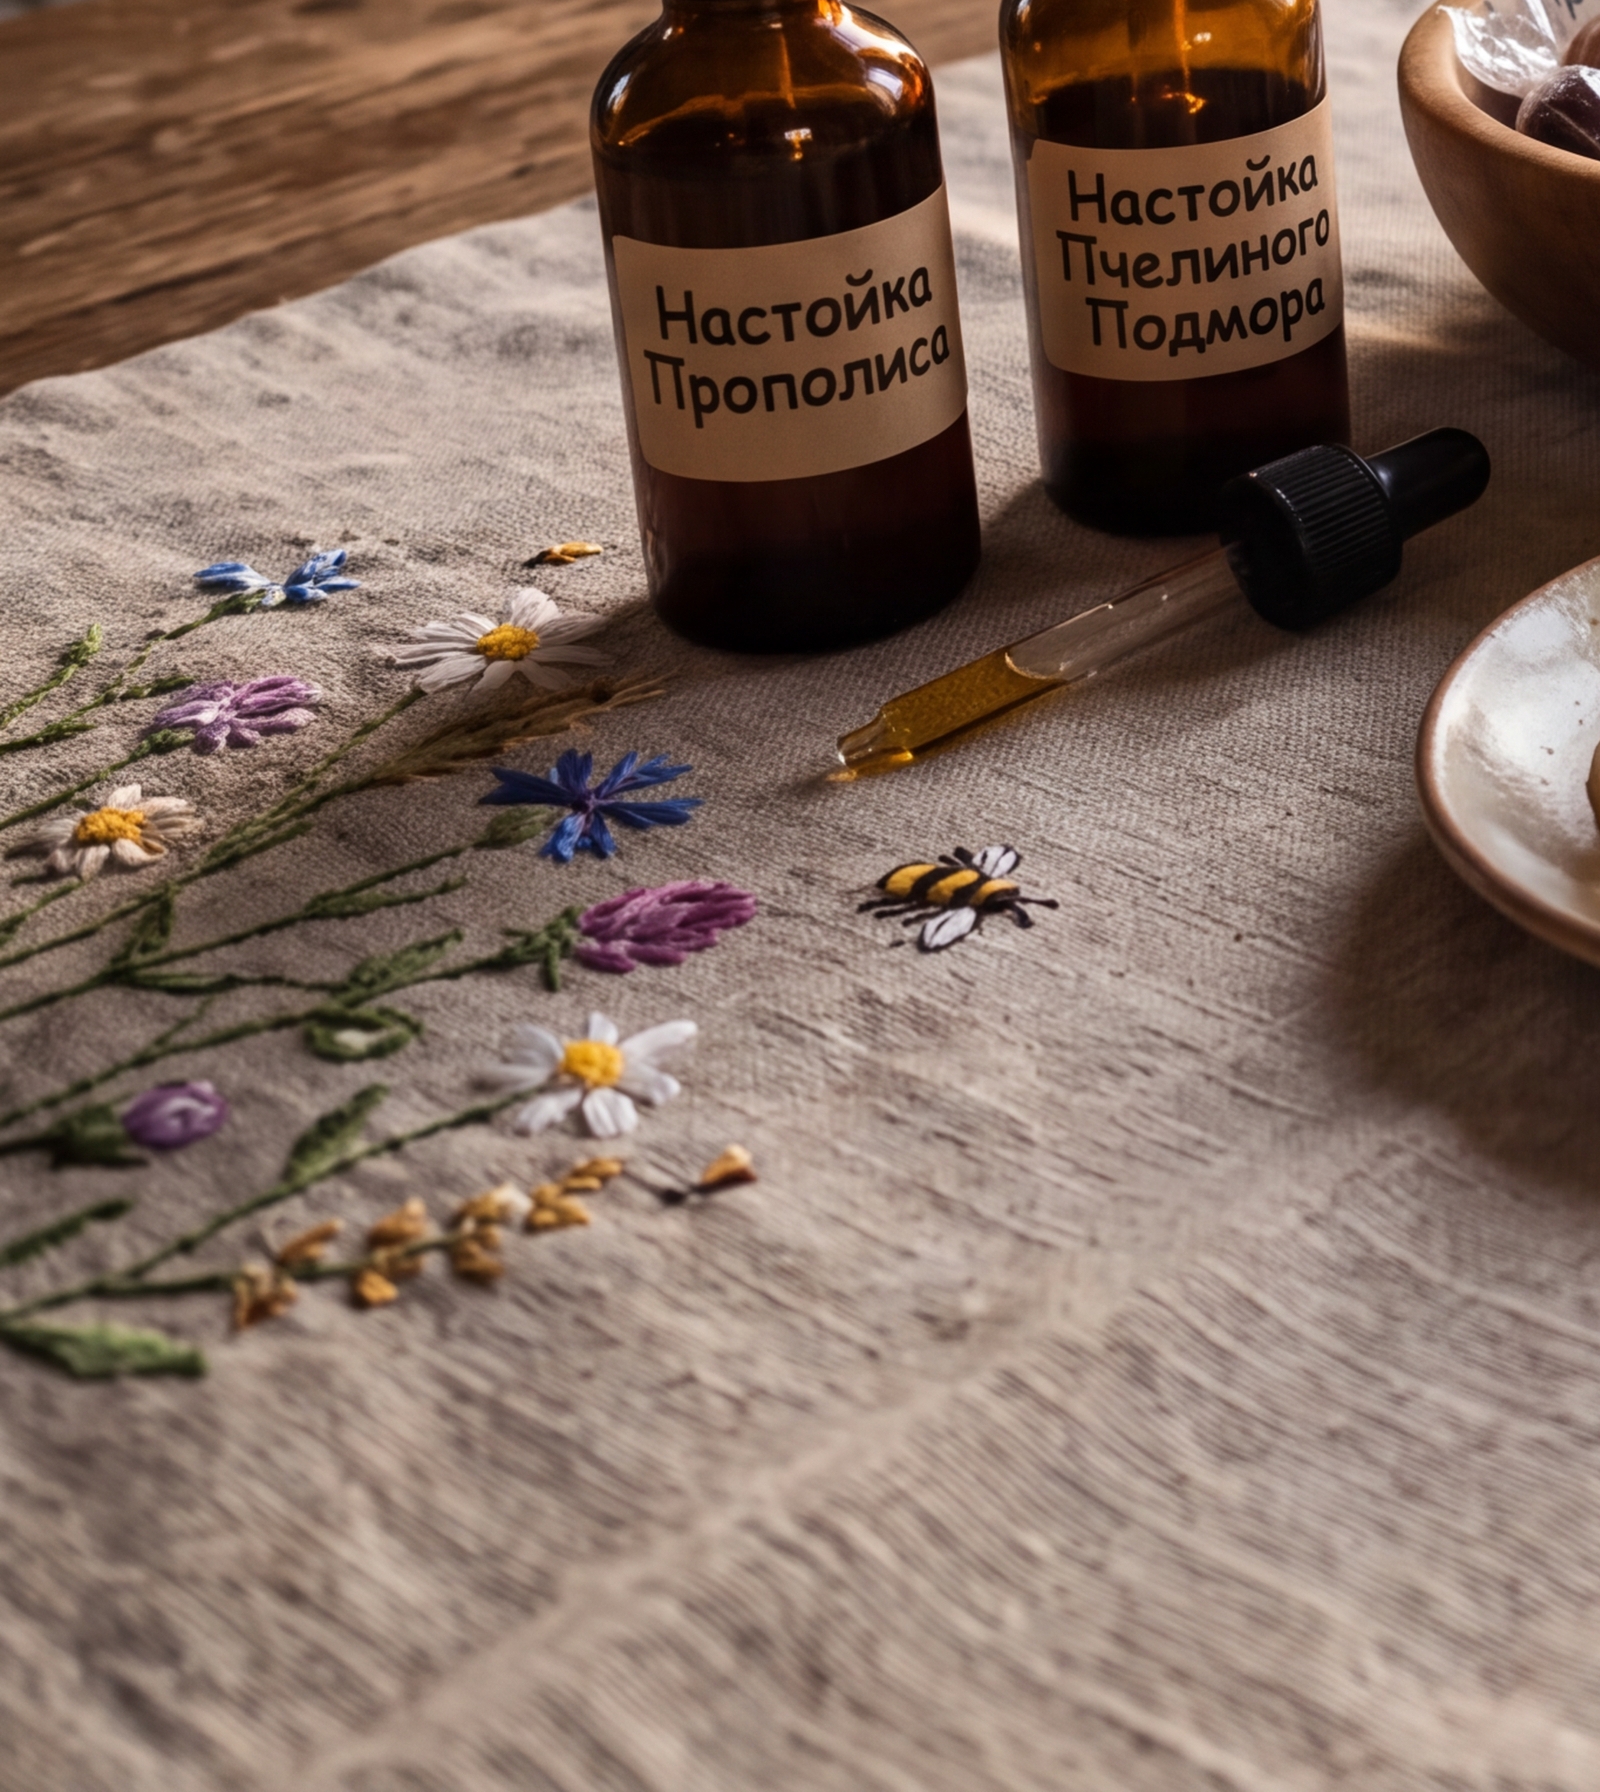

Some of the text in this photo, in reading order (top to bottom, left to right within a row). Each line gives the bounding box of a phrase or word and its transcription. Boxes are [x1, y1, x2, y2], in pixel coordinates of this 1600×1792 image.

[1066, 153, 1319, 227] Настойка
[1055, 207, 1331, 288] Пчелиного
[655, 265, 933, 346] Настойка
[1085, 276, 1326, 356] Подмора
[643, 323, 951, 429] Прополиса
